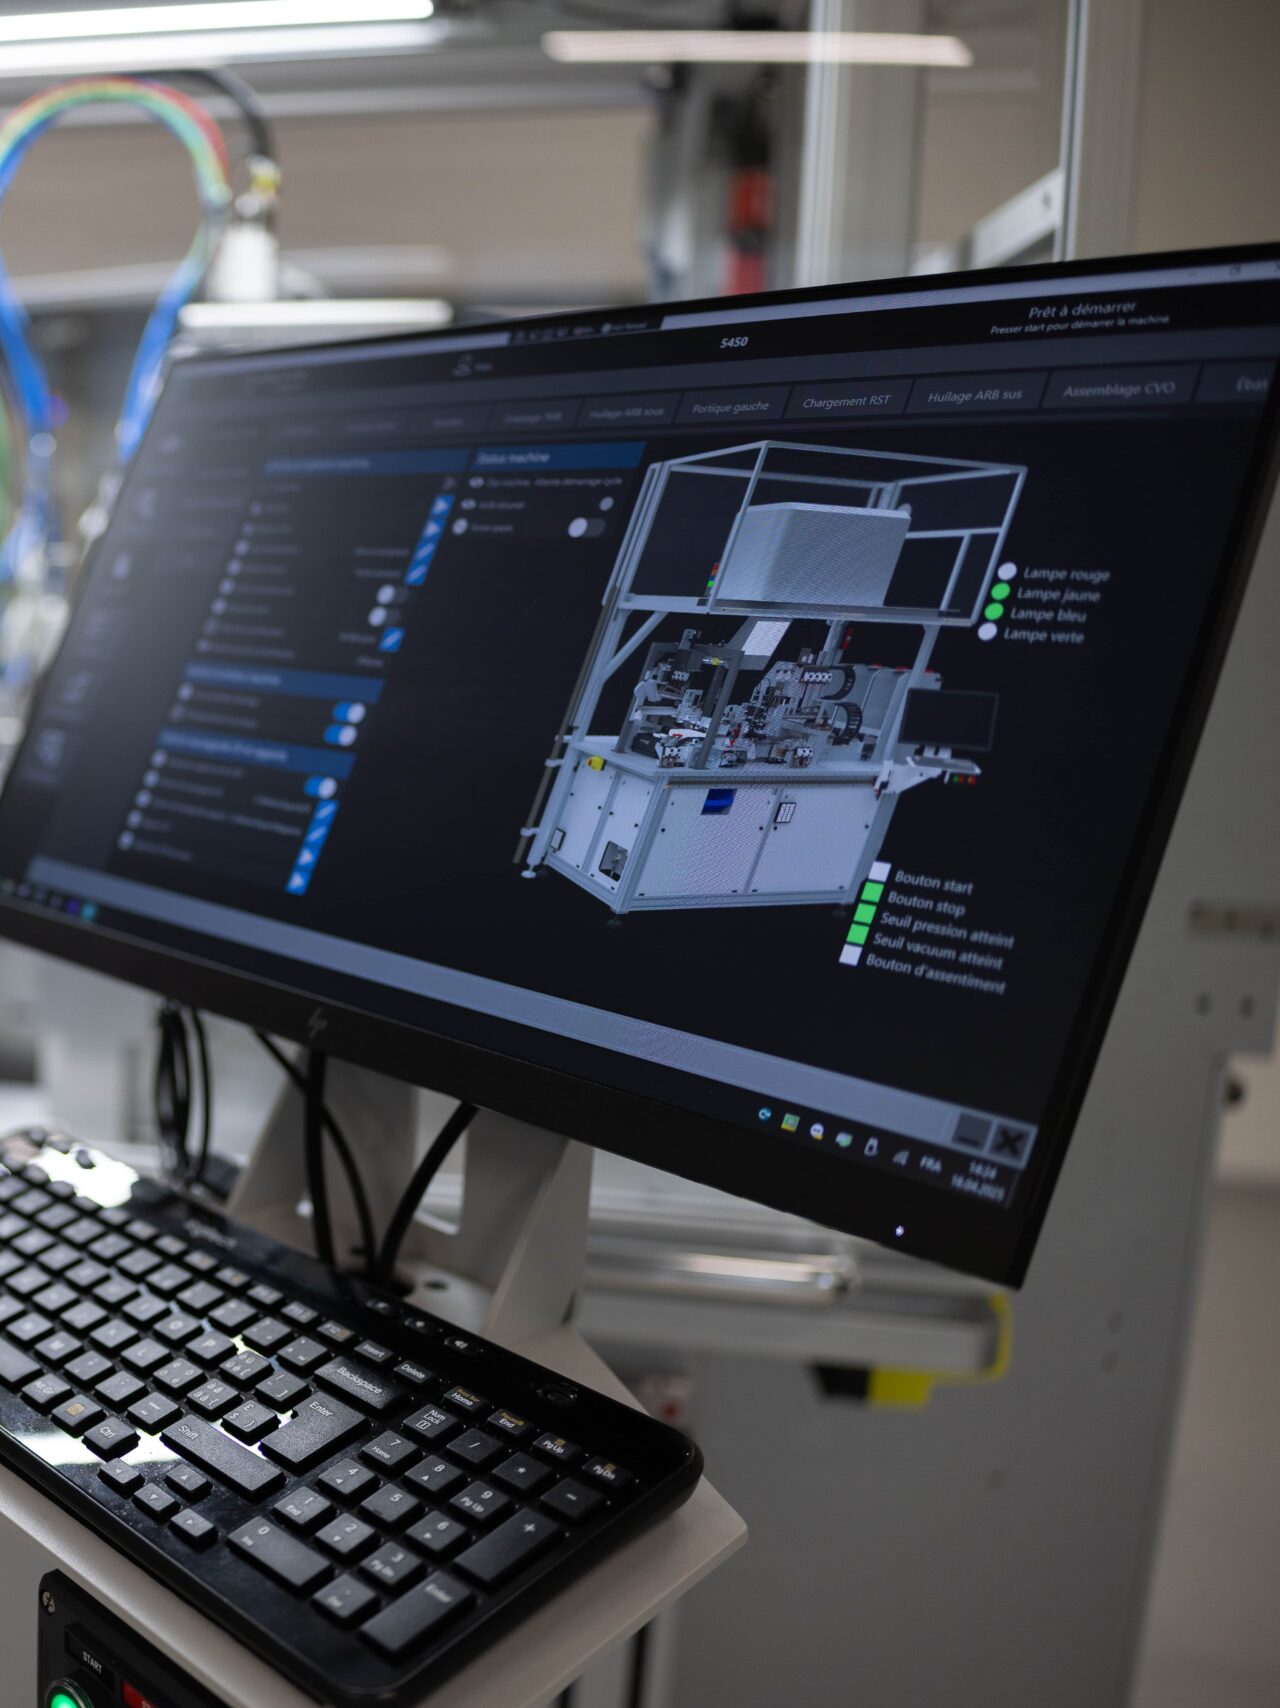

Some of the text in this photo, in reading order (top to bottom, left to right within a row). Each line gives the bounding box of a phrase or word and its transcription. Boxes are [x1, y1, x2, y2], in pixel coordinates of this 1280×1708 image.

[1028, 301, 1137, 319] Prêt à démarrer
[990, 325, 1023, 336] Presser
[1024, 323, 1046, 333] start
[1046, 323, 1070, 334] pour
[1071, 318, 1116, 330] démarrer
[1128, 314, 1171, 327] machine
[927, 389, 1023, 405] Huilage ARB sus
[1063, 382, 1142, 398] Assemblage
[691, 401, 770, 416] Portique gauche
[803, 394, 891, 410] Chargement RST
[1023, 566, 1111, 583] Lampe rouge
[1016, 586, 1101, 603] Lampe jaune
[1010, 607, 1087, 623] Lampe bleu
[1003, 627, 1086, 645] Lampe verte
[895, 870, 974, 896] Bouton start
[888, 891, 967, 919] Bouton stop
[880, 912, 1015, 950] Seuil pression atteint
[873, 933, 1004, 970] Seuil vacuum atteint
[866, 954, 1006, 993] Bouton d'assentiment
[919, 1154, 943, 1175] FRA
[362, 1343, 385, 1358] Insert
[401, 1363, 426, 1379] Delete
[336, 1366, 382, 1394] Backspace
[451, 1391, 473, 1406] Home
[308, 1400, 333, 1418] Enter
[429, 1409, 446, 1422] Num
[423, 1413, 441, 1426] Lock
[499, 1417, 516, 1429] End
[100, 1425, 117, 1440] Ctrl
[177, 1424, 198, 1440] Shift
[388, 1438, 401, 1447] 7
[372, 1446, 391, 1460] Home
[346, 1466, 359, 1476] 4
[433, 1463, 445, 1473] 8
[389, 1493, 402, 1503] 5
[480, 1490, 493, 1500] 9
[344, 1523, 358, 1533] 2
[437, 1521, 450, 1531] 6
[391, 1553, 405, 1563] 3
[82, 1650, 103, 1674] START
